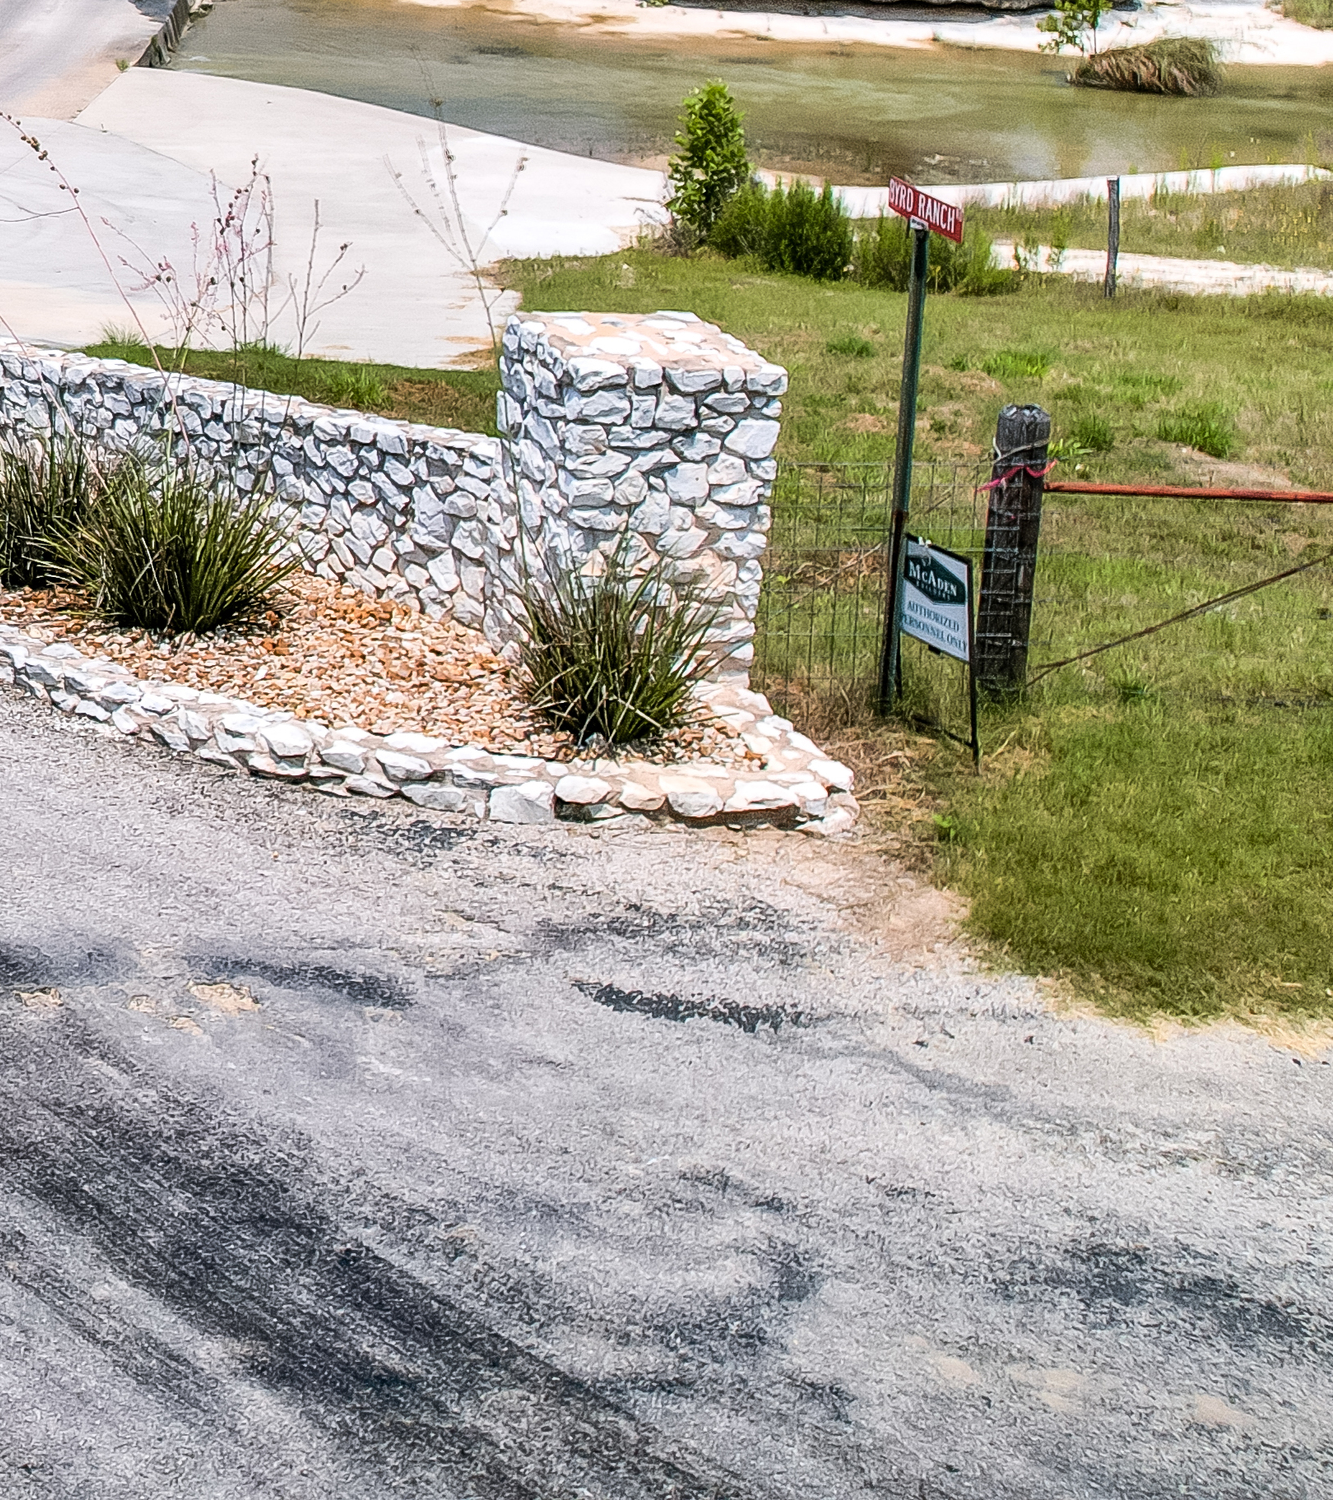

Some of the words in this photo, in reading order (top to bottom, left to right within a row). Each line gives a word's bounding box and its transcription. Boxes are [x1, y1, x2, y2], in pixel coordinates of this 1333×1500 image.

[889, 178, 914, 213] BYRD
[918, 193, 956, 234] RANCH
[907, 600, 960, 633] AUTHORIZED
